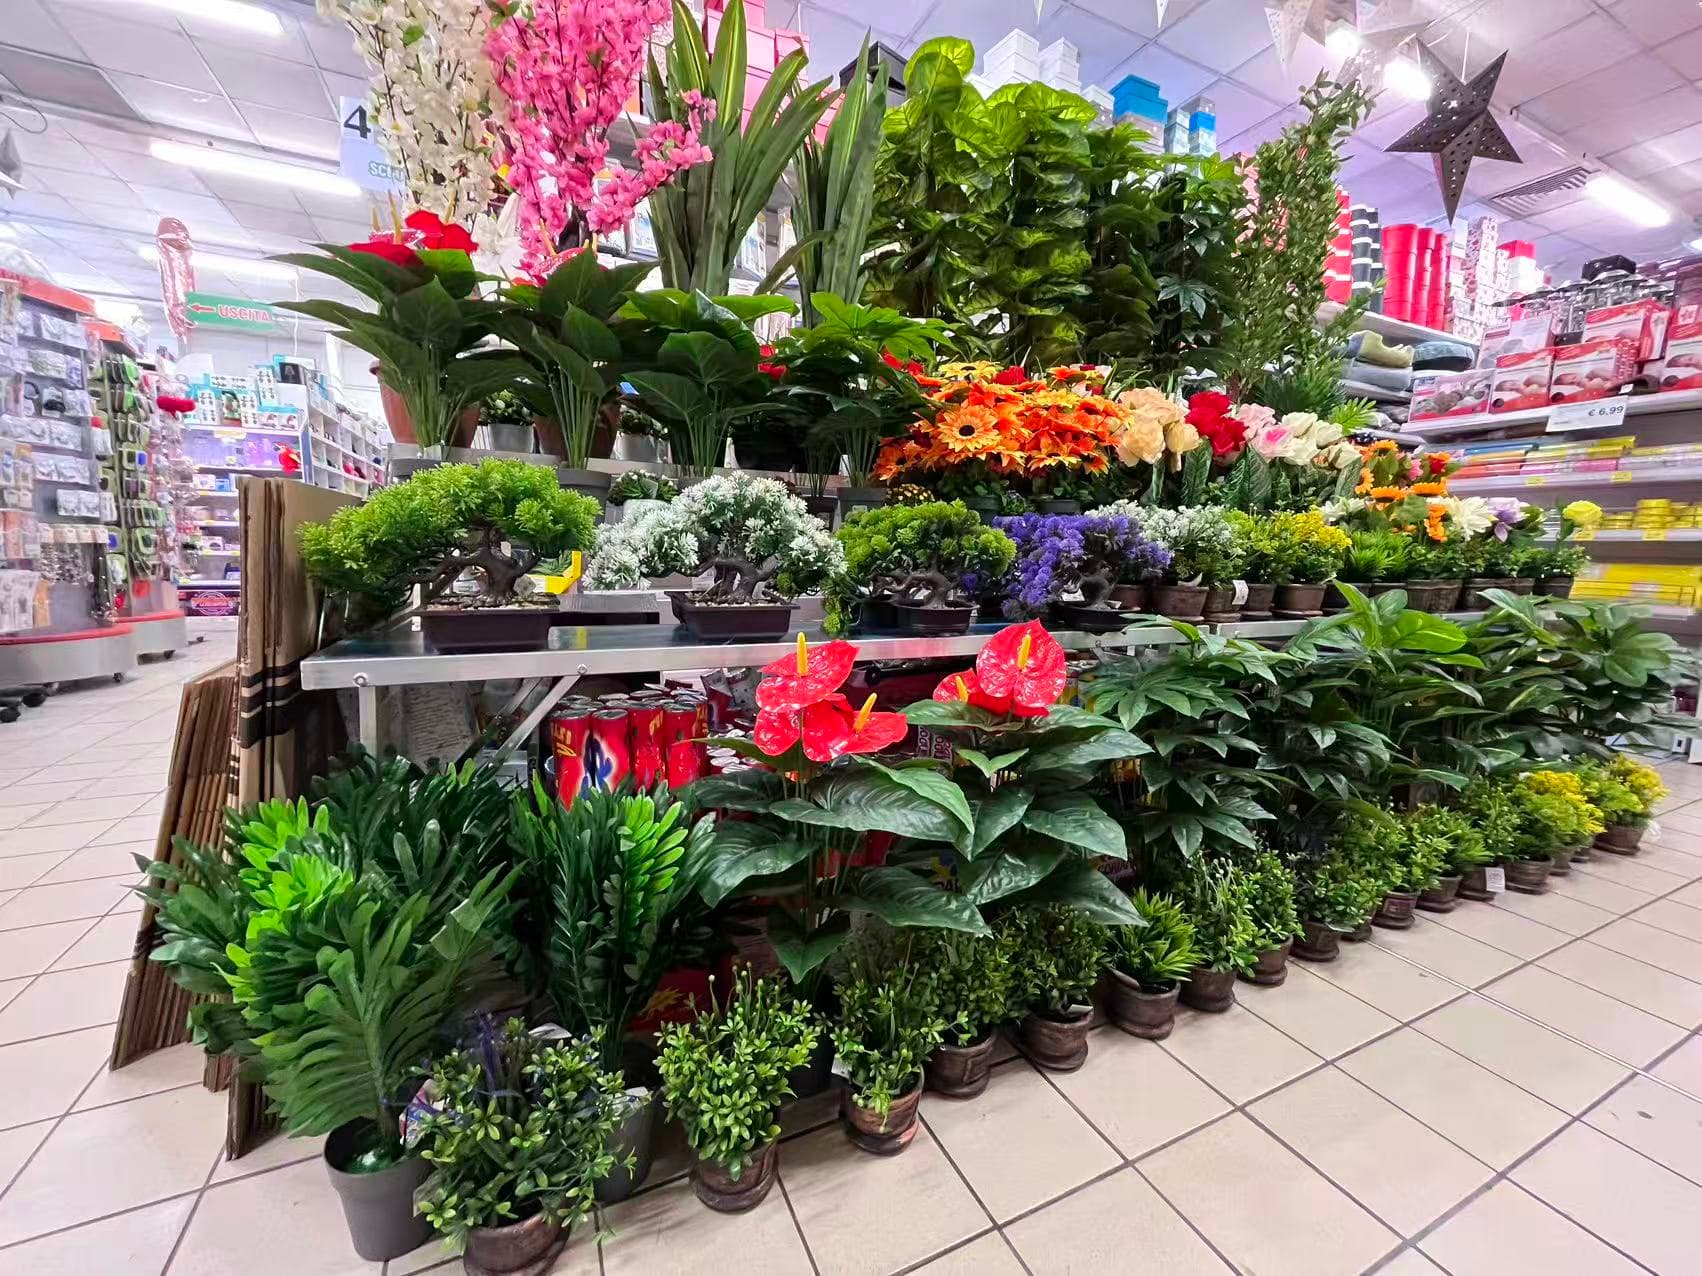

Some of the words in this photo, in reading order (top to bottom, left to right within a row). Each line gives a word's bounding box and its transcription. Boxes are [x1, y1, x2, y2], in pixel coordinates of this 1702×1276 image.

[344, 105, 371, 139] 4
[218, 304, 273, 322] USCITA
[1598, 405, 1624, 416] 6.99
